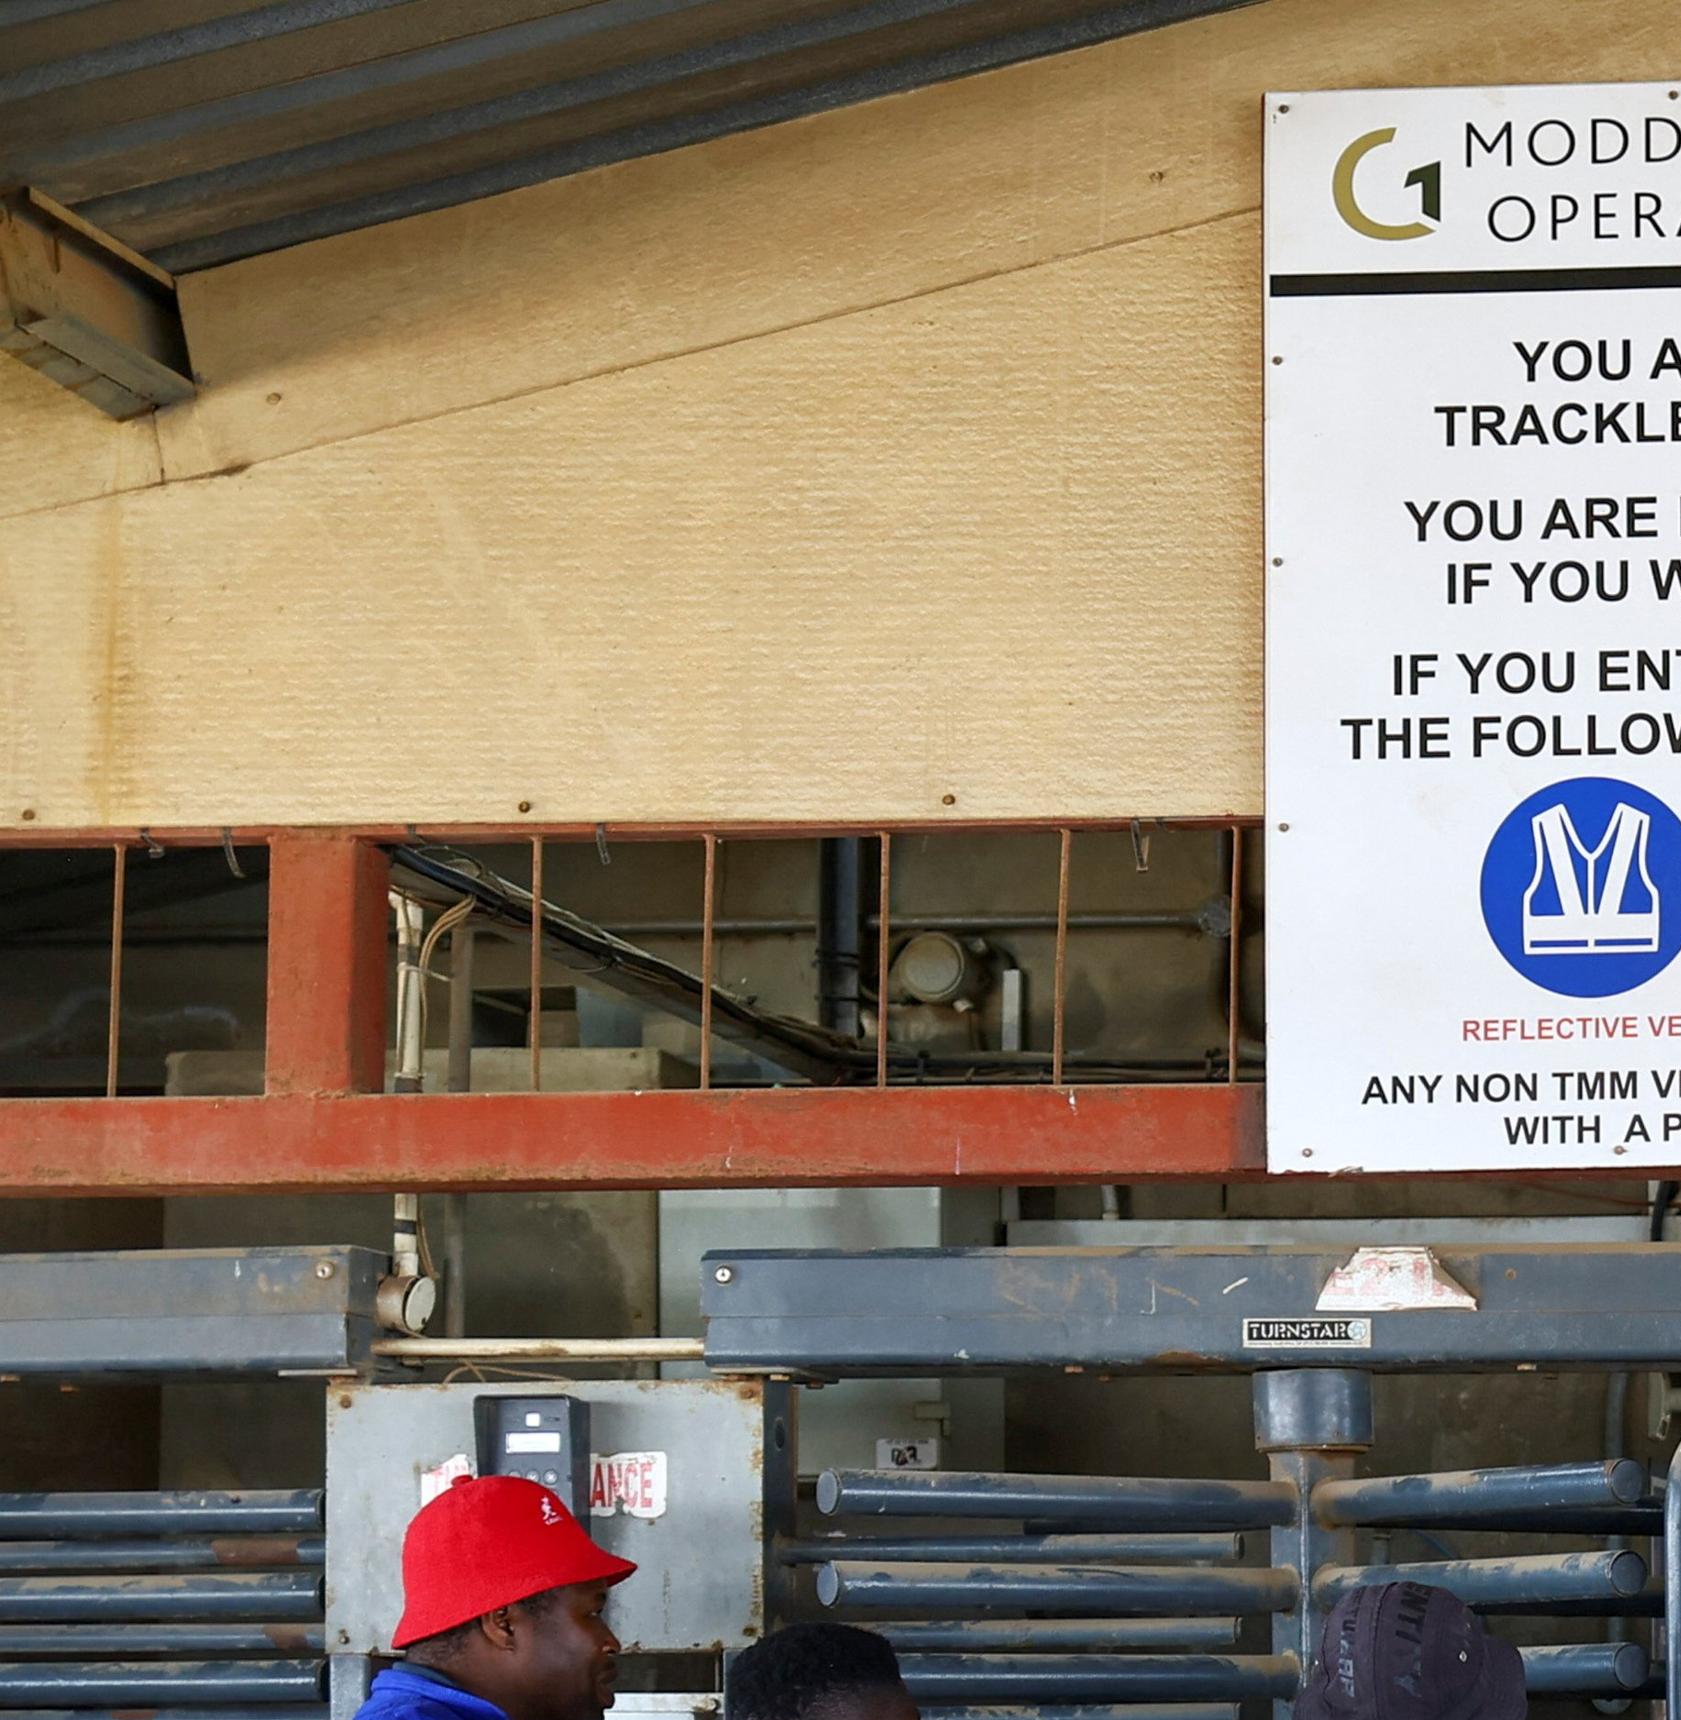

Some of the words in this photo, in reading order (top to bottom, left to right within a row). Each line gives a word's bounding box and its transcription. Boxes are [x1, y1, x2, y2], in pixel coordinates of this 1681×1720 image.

[1514, 340, 1630, 382] YOU
[1405, 500, 1522, 541] YOU
[1541, 497, 1657, 539] ARE
[1448, 563, 1491, 604] IF
[1511, 561, 1628, 602] YOU
[1394, 655, 1438, 695] IF
[1457, 652, 1574, 693] YOU
[1341, 718, 1450, 759] THE
[1462, 1016, 1640, 1042] REFLECTIVE
[1362, 1075, 1442, 1104] ANY
[1457, 1074, 1536, 1102] NON
[1552, 1071, 1637, 1100] TMM
[1505, 1116, 1599, 1144] WITH
[1625, 1115, 1650, 1142] A
[1248, 1323, 1346, 1340] TURNSTAR
